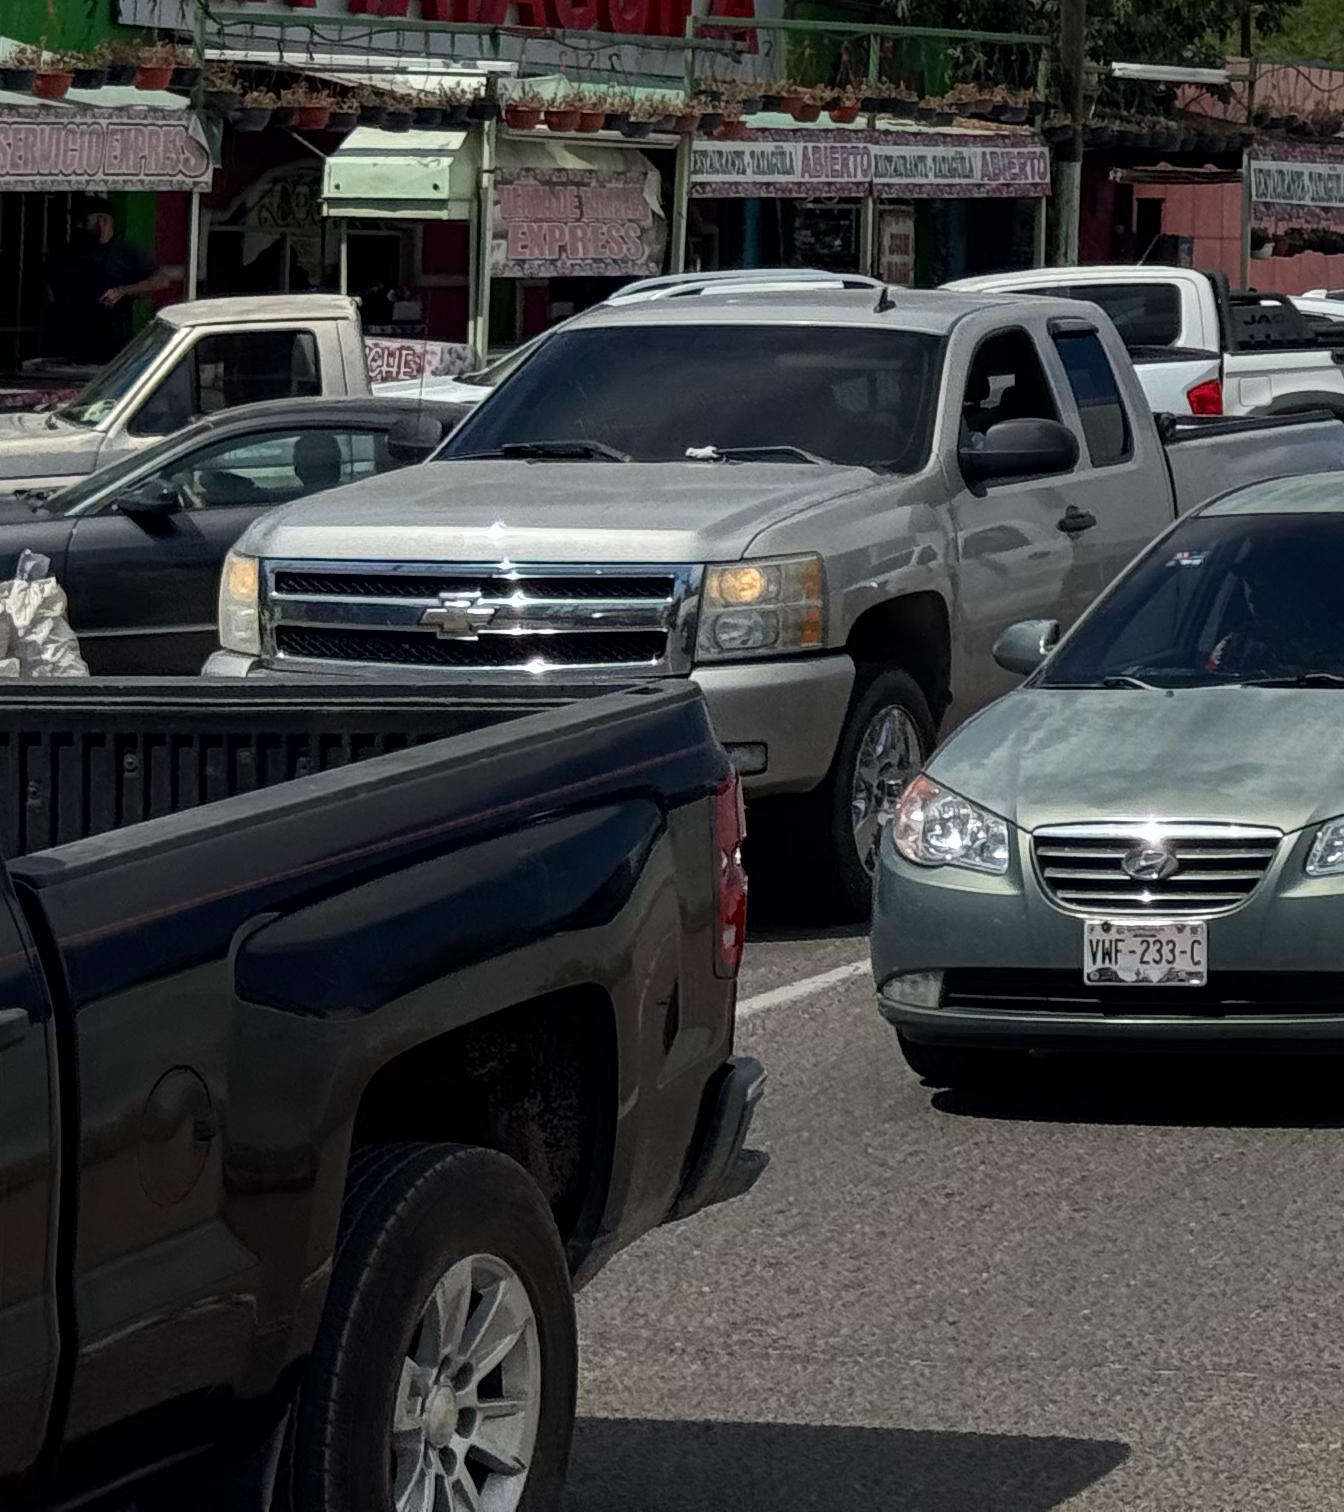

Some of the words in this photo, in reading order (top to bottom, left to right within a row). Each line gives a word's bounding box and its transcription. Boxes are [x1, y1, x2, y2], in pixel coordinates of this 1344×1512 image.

[800, 145, 872, 178] ABIERTO
[980, 150, 1048, 181] ABIERTO
[507, 221, 646, 260] EXPRESS
[1089, 939, 1202, 966] VWF-233-C
